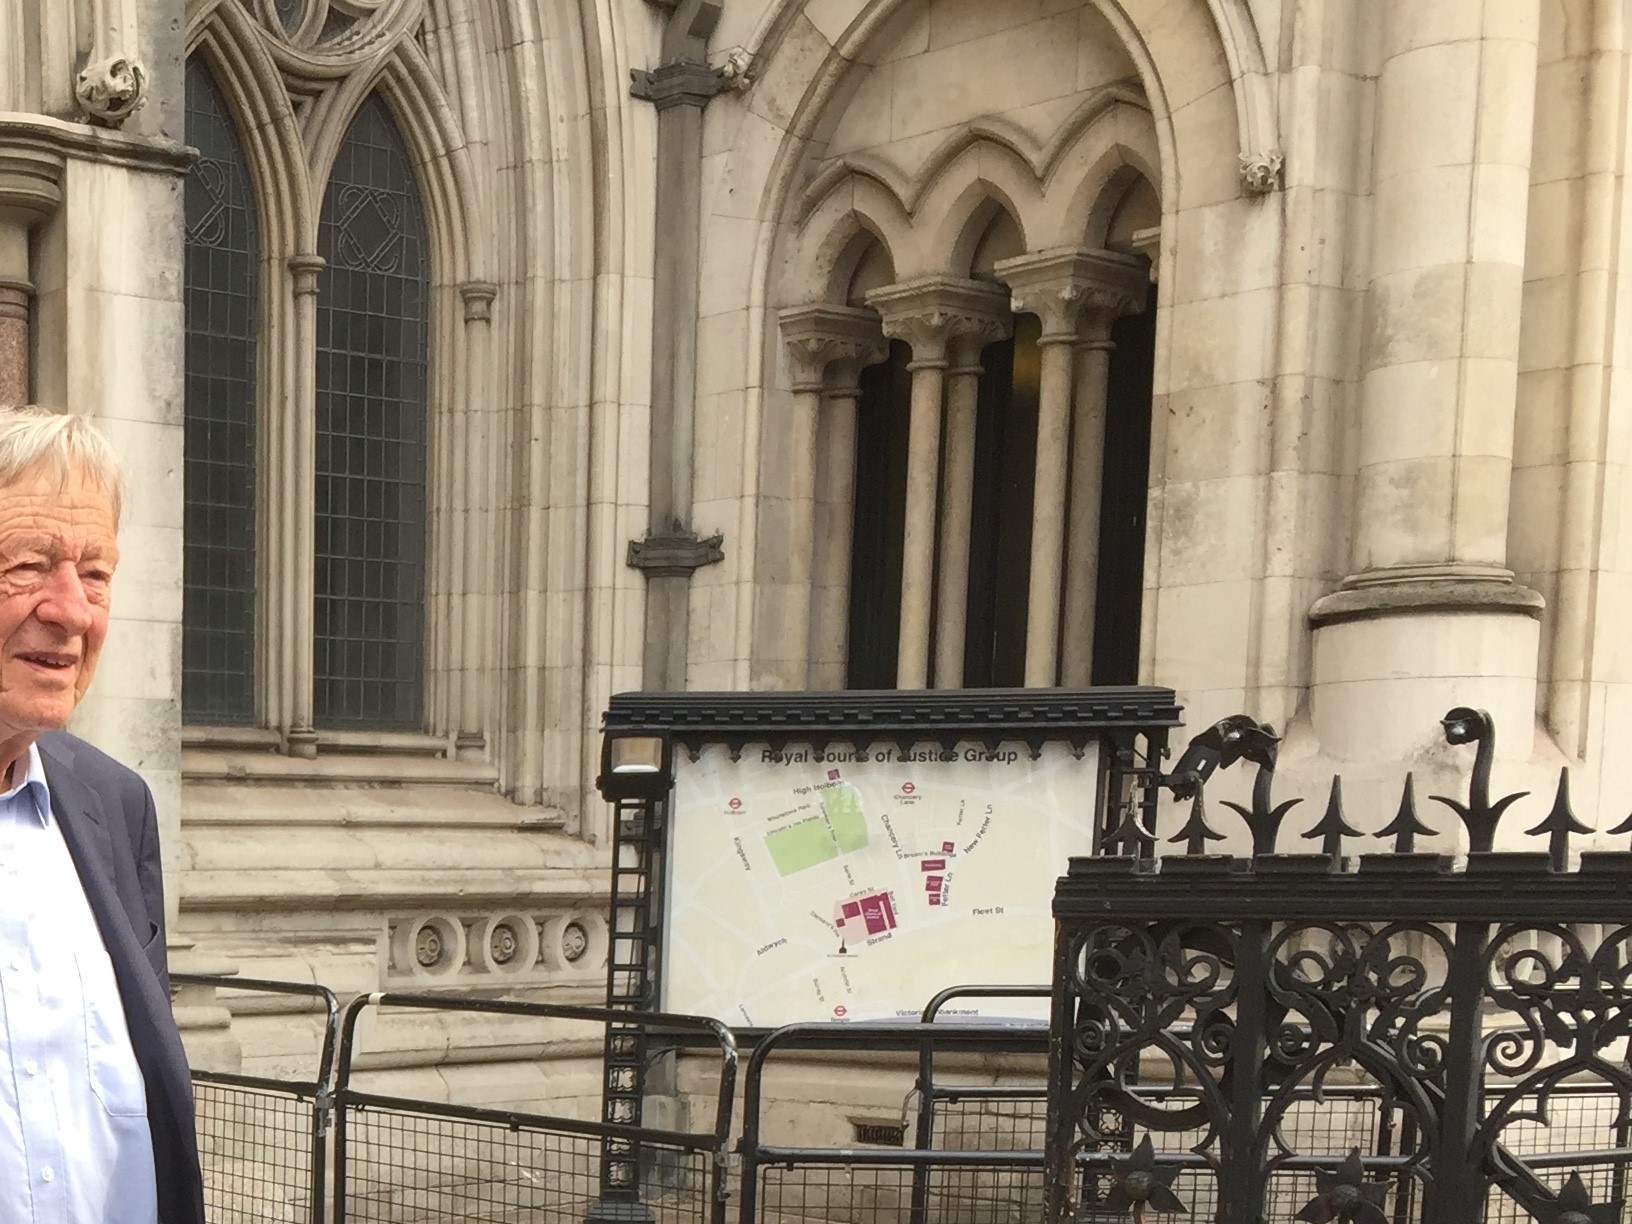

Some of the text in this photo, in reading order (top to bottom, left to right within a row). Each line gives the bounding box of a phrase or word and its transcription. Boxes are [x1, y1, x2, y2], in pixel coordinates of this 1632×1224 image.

[761, 749, 808, 766] Ryal
[814, 749, 870, 763] ours
[875, 748, 891, 763] of
[793, 780, 845, 796] High Holborn
[881, 814, 904, 860] Chancery Ln
[963, 804, 993, 854] New Fetter Ln
[733, 836, 751, 871] Kingsway
[941, 872, 953, 906] Fetter Ln
[972, 906, 1004, 916] Fleet St
[756, 937, 788, 956] Aldwych
[866, 931, 893, 947] Strand
[895, 1008, 923, 1017] Victori
